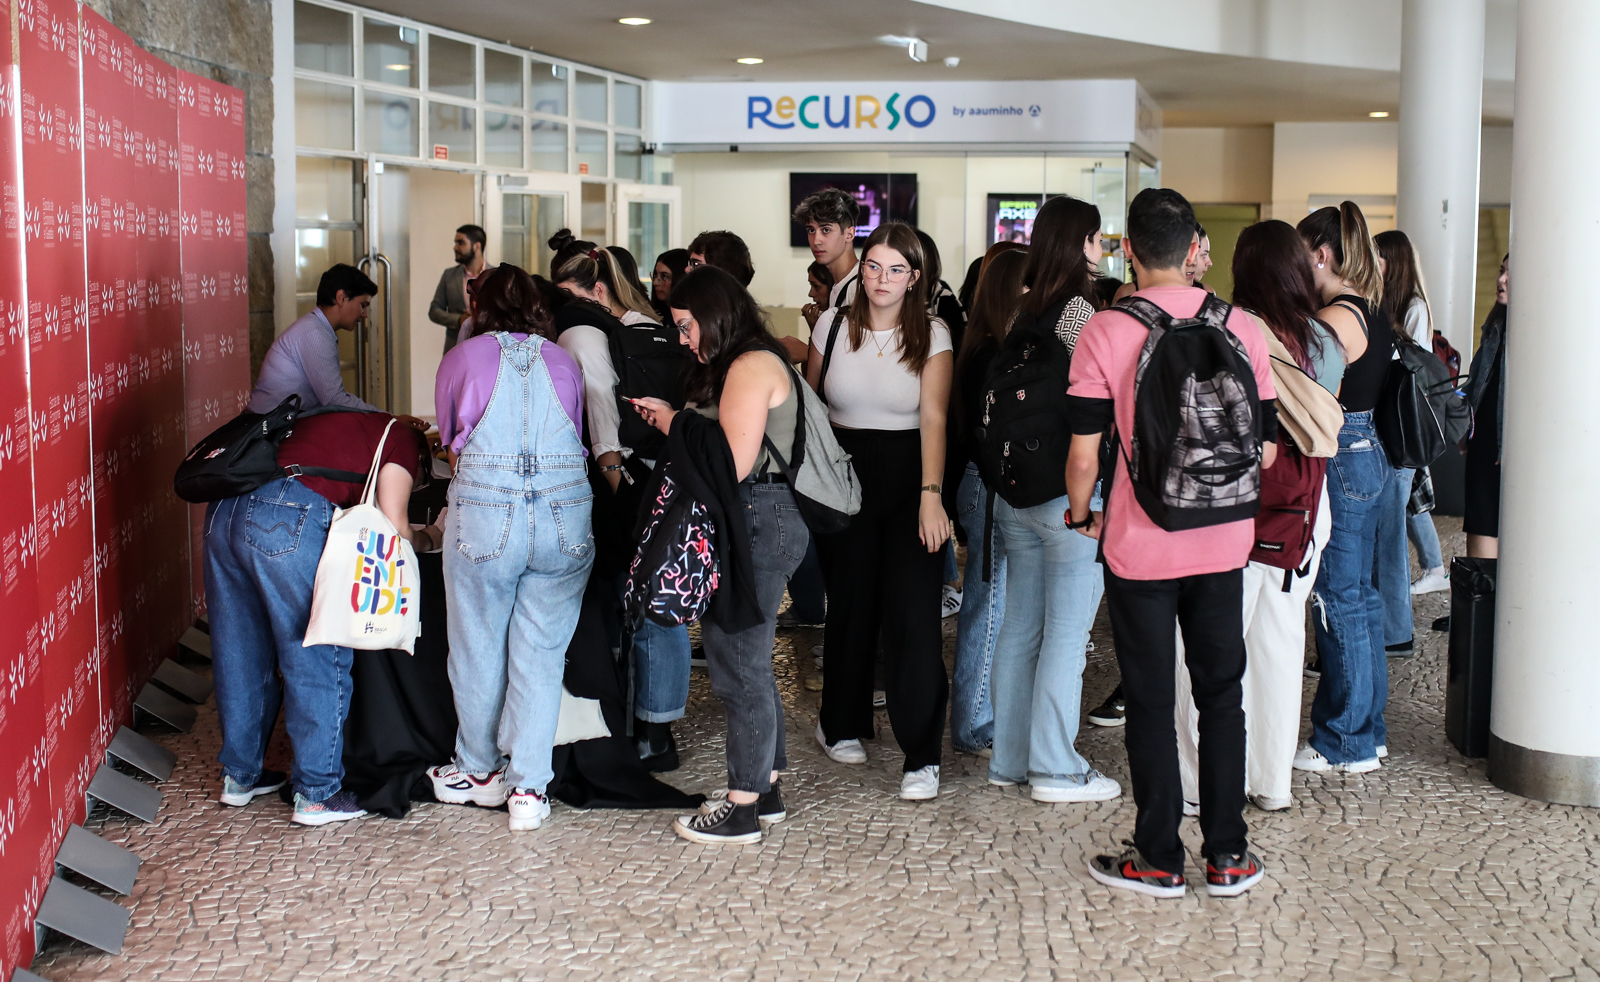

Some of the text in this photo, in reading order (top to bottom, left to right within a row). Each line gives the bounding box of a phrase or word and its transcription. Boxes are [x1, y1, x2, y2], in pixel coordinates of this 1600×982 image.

[953, 105, 1023, 118] by aauminho
[999, 208, 1037, 220] AXE
[351, 582, 411, 617] UDE
